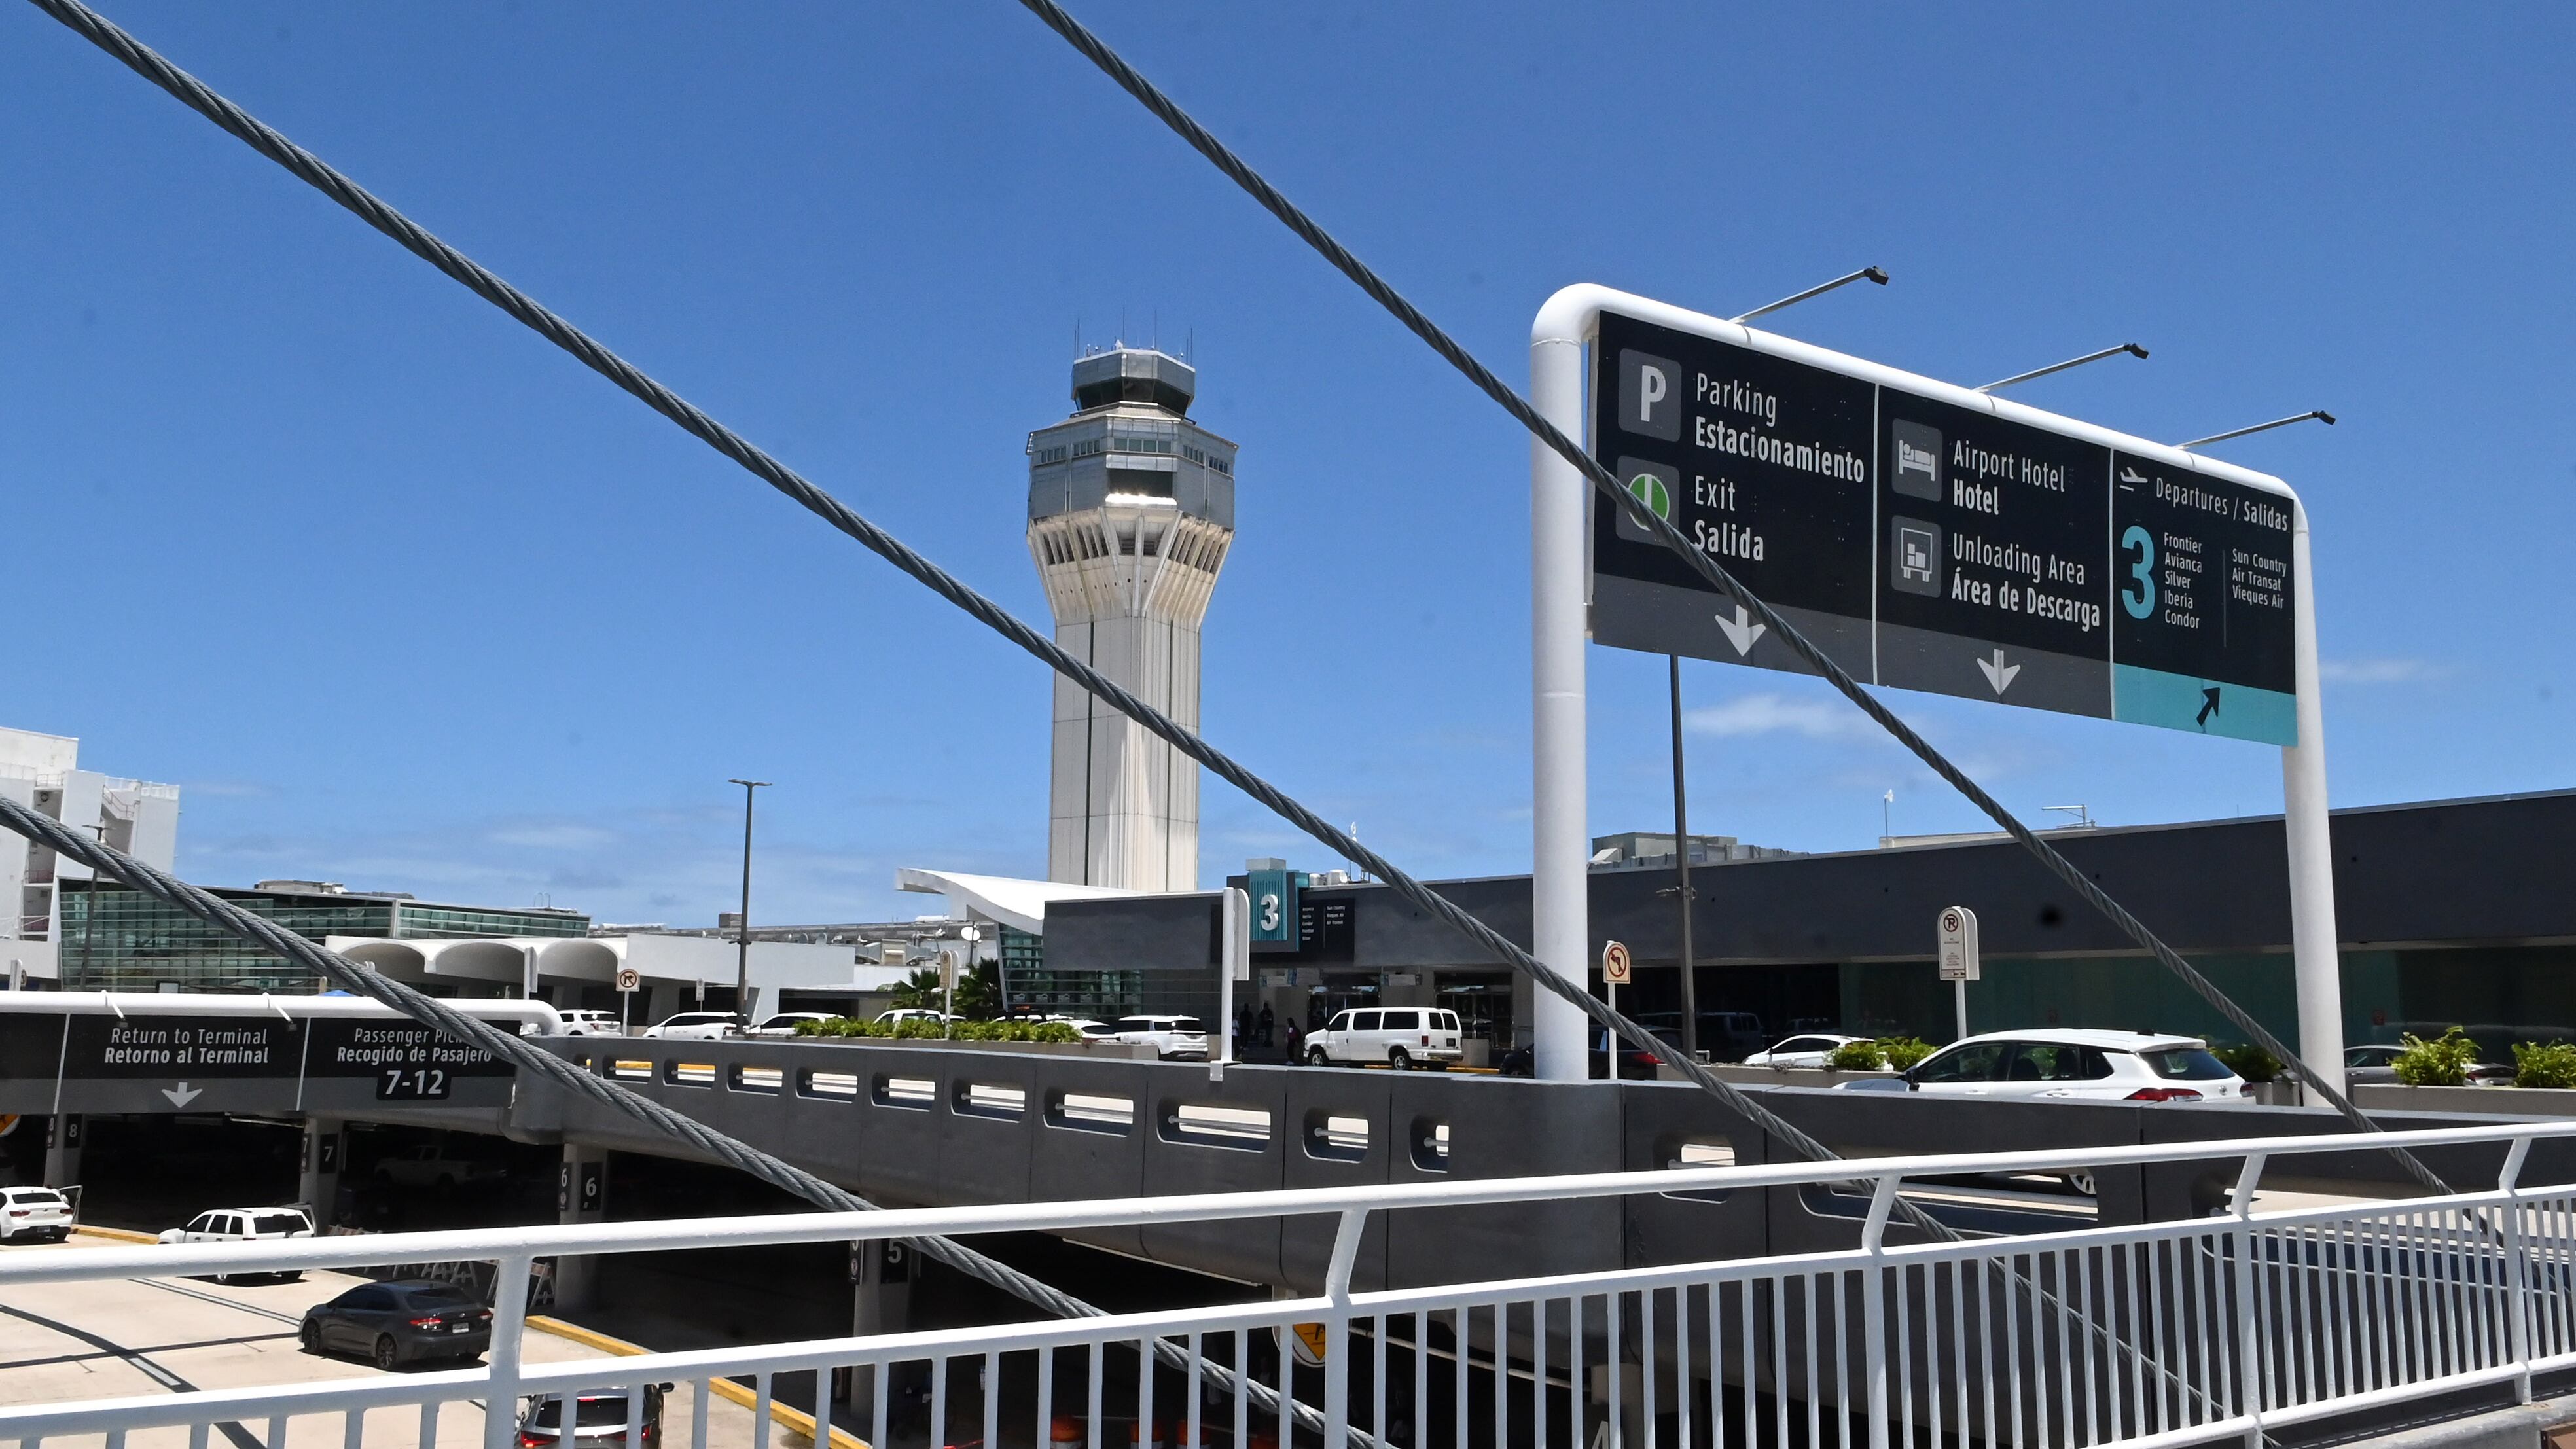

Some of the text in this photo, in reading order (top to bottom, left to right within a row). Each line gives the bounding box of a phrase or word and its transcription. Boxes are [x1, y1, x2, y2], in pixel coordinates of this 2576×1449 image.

[1641, 365, 1666, 422] P
[1697, 372, 1776, 427] Parking
[1695, 416, 1865, 483] Estacionamiento
[1954, 440, 2065, 493] Airport Hotel
[1695, 475, 1736, 512] Exit
[1954, 479, 1999, 515] Hotel
[2156, 477, 2287, 531] Departures / Salidas
[1694, 520, 1764, 562] Salida
[2164, 532, 2202, 554] Frontier
[1953, 533, 2084, 585] Unloading Area
[2165, 552, 2202, 573] Avianca
[2232, 548, 2287, 577] Sun Country
[2122, 526, 2155, 619] 3
[2165, 571, 2191, 589] Silver
[2232, 567, 2281, 591] Air Transat
[1952, 567, 2100, 632] Área de Descarga
[2164, 590, 2192, 609] Iberia
[2232, 584, 2283, 609] Vieques Air
[2165, 609, 2200, 629] Condor
[1261, 894, 1279, 931] 3
[111, 1028, 267, 1044] Return to Terminal
[354, 1028, 429, 1046] Passenger
[105, 1046, 268, 1064] Retorno al Terminal
[337, 1046, 492, 1065] Recogido de Pasajero
[385, 1069, 444, 1094] 7-12
[69, 1124, 77, 1137] 8
[325, 1146, 333, 1162] 7
[562, 1168, 567, 1187] 6
[586, 1177, 596, 1196] 6
[888, 1238, 901, 1263] 5
